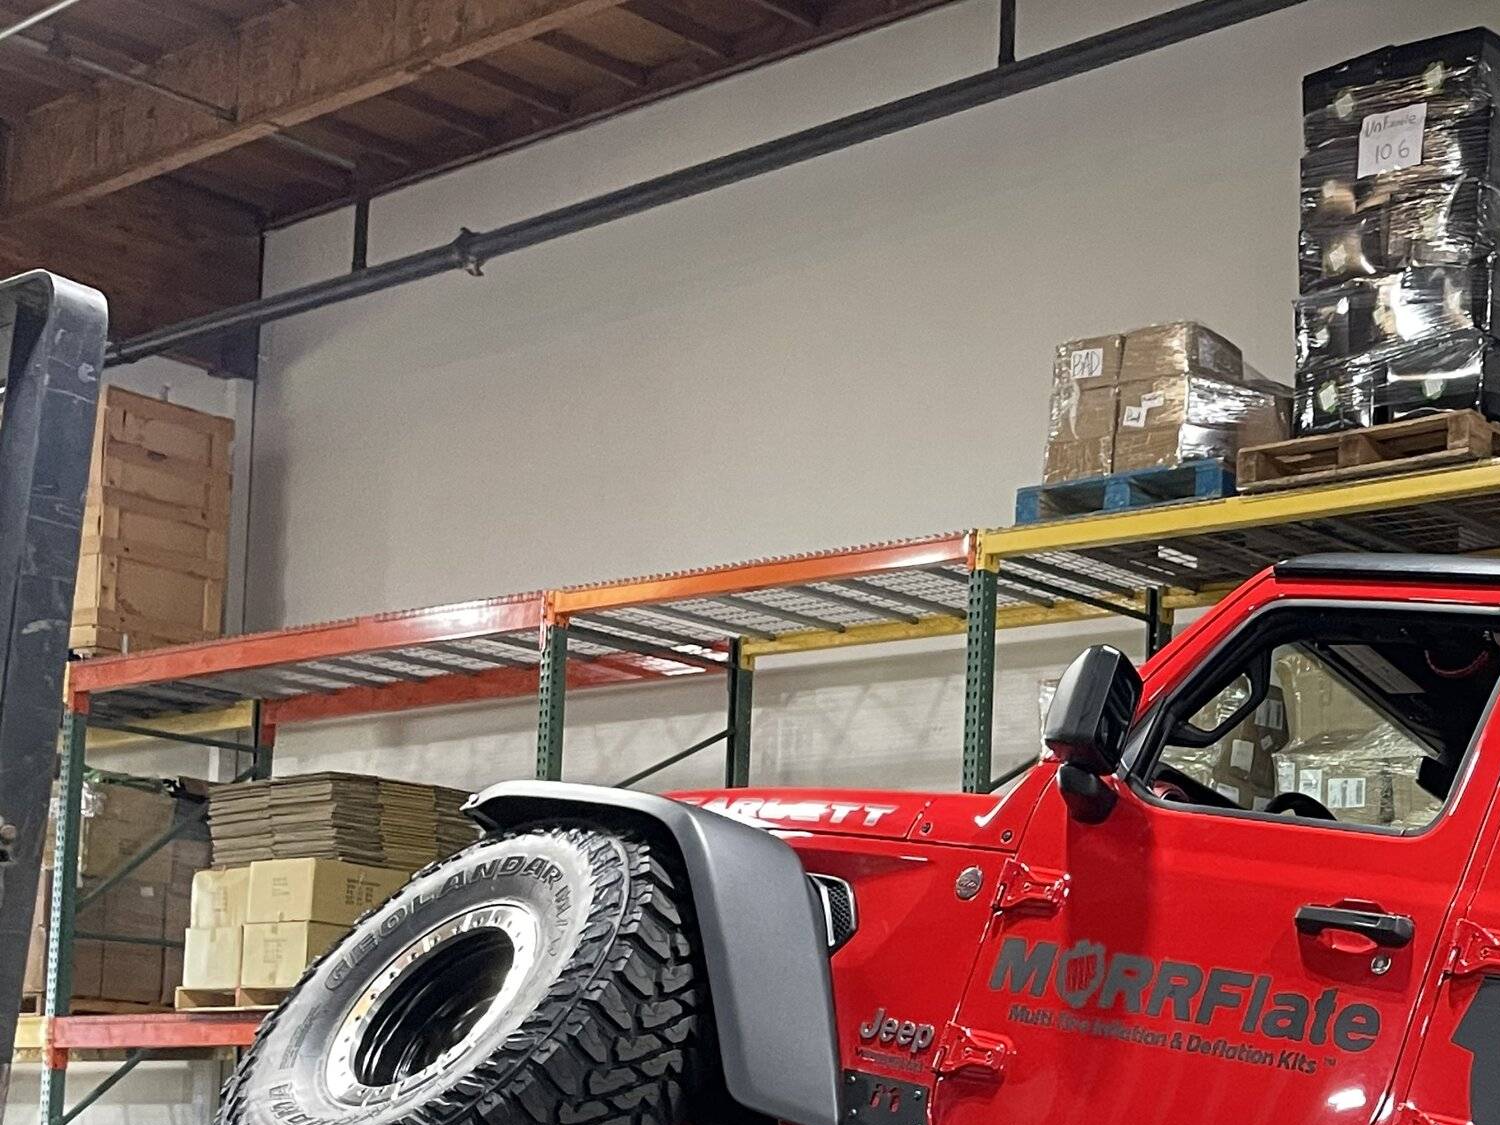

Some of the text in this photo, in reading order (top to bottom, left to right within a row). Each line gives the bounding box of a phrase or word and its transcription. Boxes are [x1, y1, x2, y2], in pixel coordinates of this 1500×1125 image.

[859, 1007, 935, 1054] Jeep
[1170, 1032, 1182, 1050] &
[1186, 1034, 1275, 1067] Deflation
[1276, 1049, 1318, 1074] Kits
